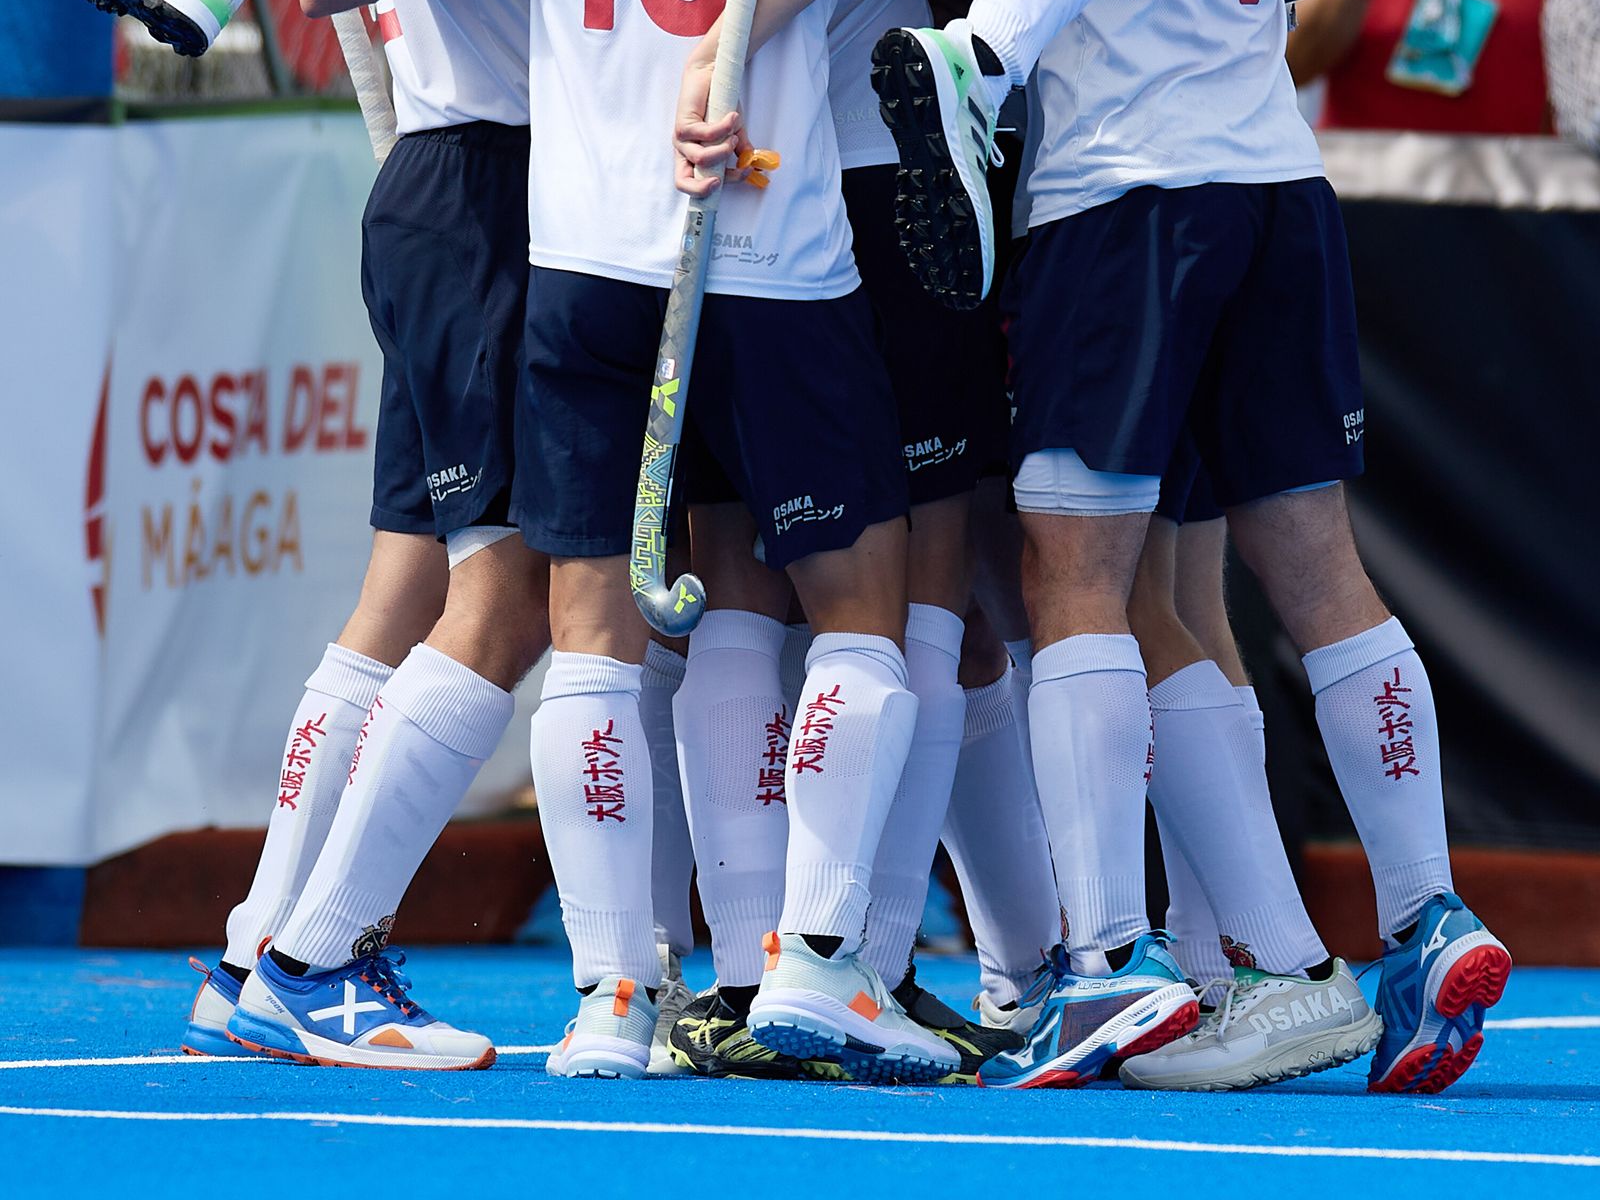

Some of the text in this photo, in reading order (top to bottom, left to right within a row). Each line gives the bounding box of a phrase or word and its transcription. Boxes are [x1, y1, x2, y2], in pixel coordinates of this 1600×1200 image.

[711, 232, 753, 249] SAKA
[711, 248, 780, 267] レーニング
[283, 360, 368, 455] DEL
[902, 436, 943, 458] SAKA
[905, 439, 967, 471] レーニング
[427, 464, 468, 490] OSAKA
[773, 495, 814, 521] OSAKA
[776, 504, 845, 535] トレーニング
[1247, 985, 1350, 1035] OSAKA
